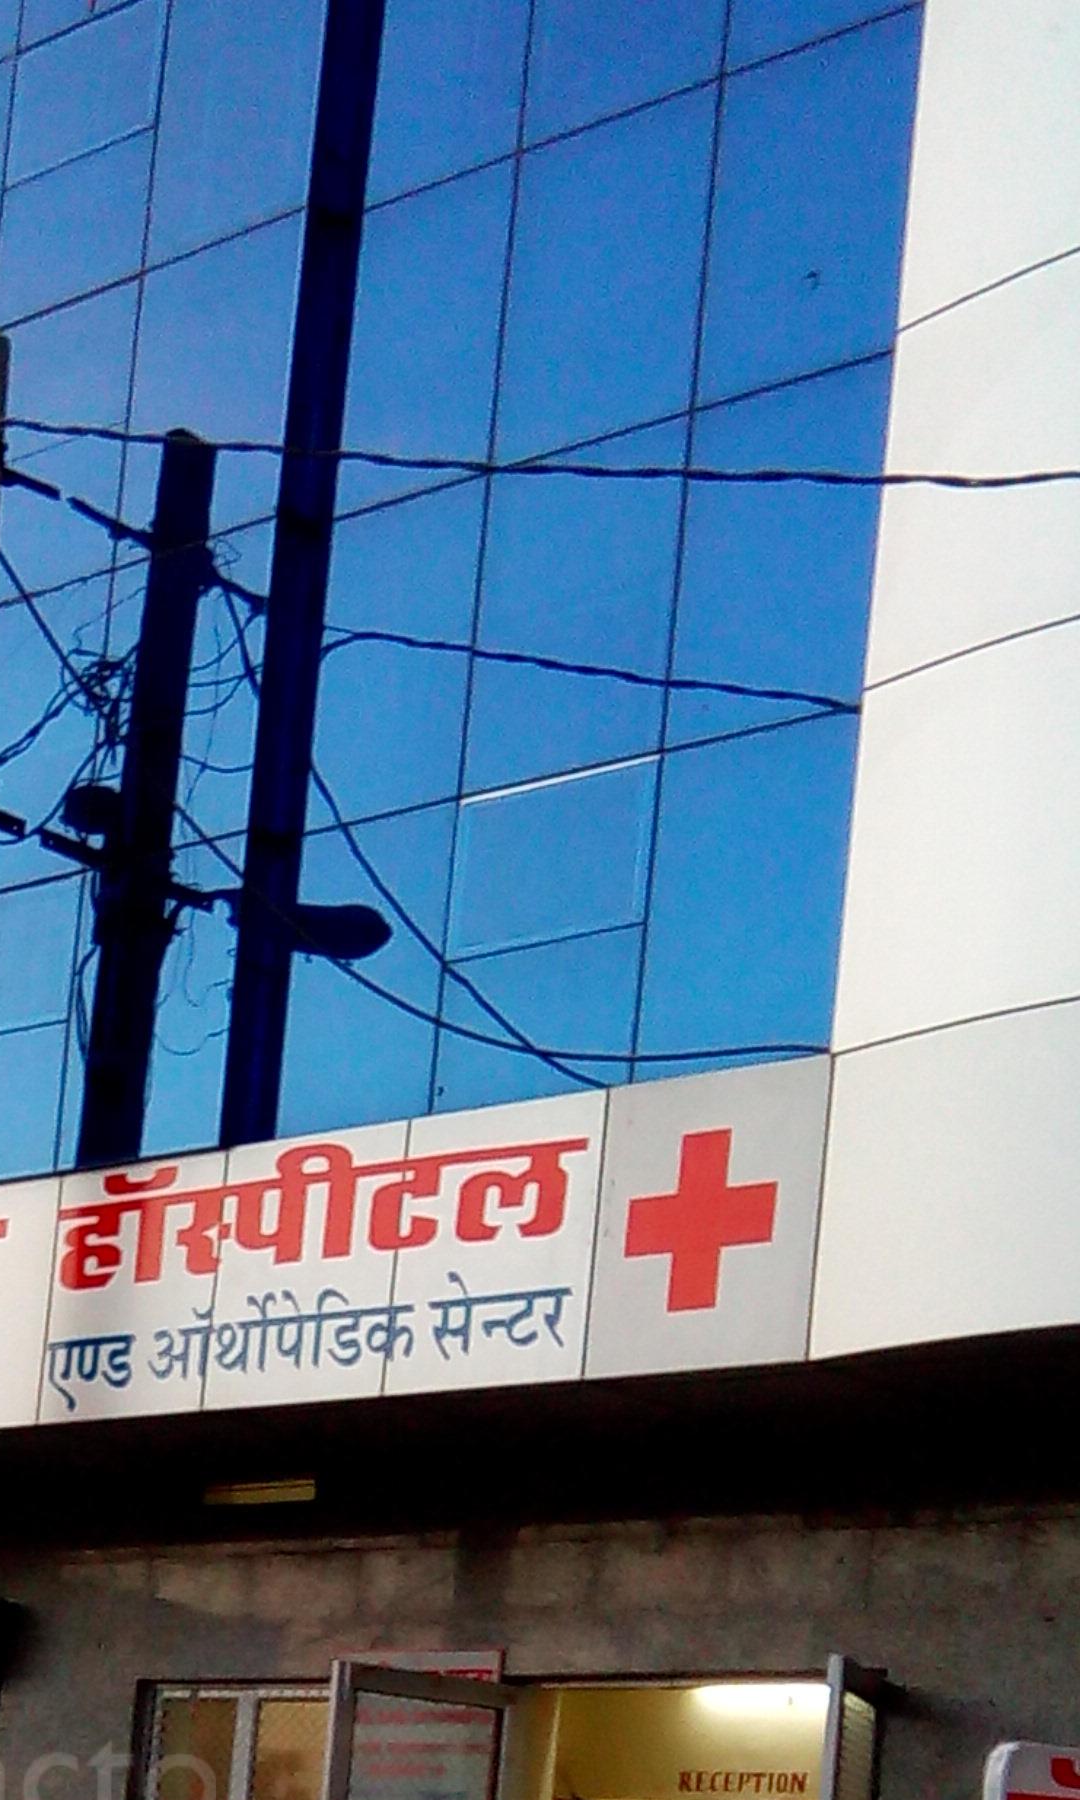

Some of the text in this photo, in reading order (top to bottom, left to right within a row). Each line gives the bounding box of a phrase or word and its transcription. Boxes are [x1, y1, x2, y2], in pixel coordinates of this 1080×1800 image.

[57, 1142, 589, 1291] हॉस्पीटल
[48, 1333, 136, 1412] एण्ड
[428, 1271, 572, 1362] सेन्टर
[678, 1770, 809, 1794] RECEPTION
